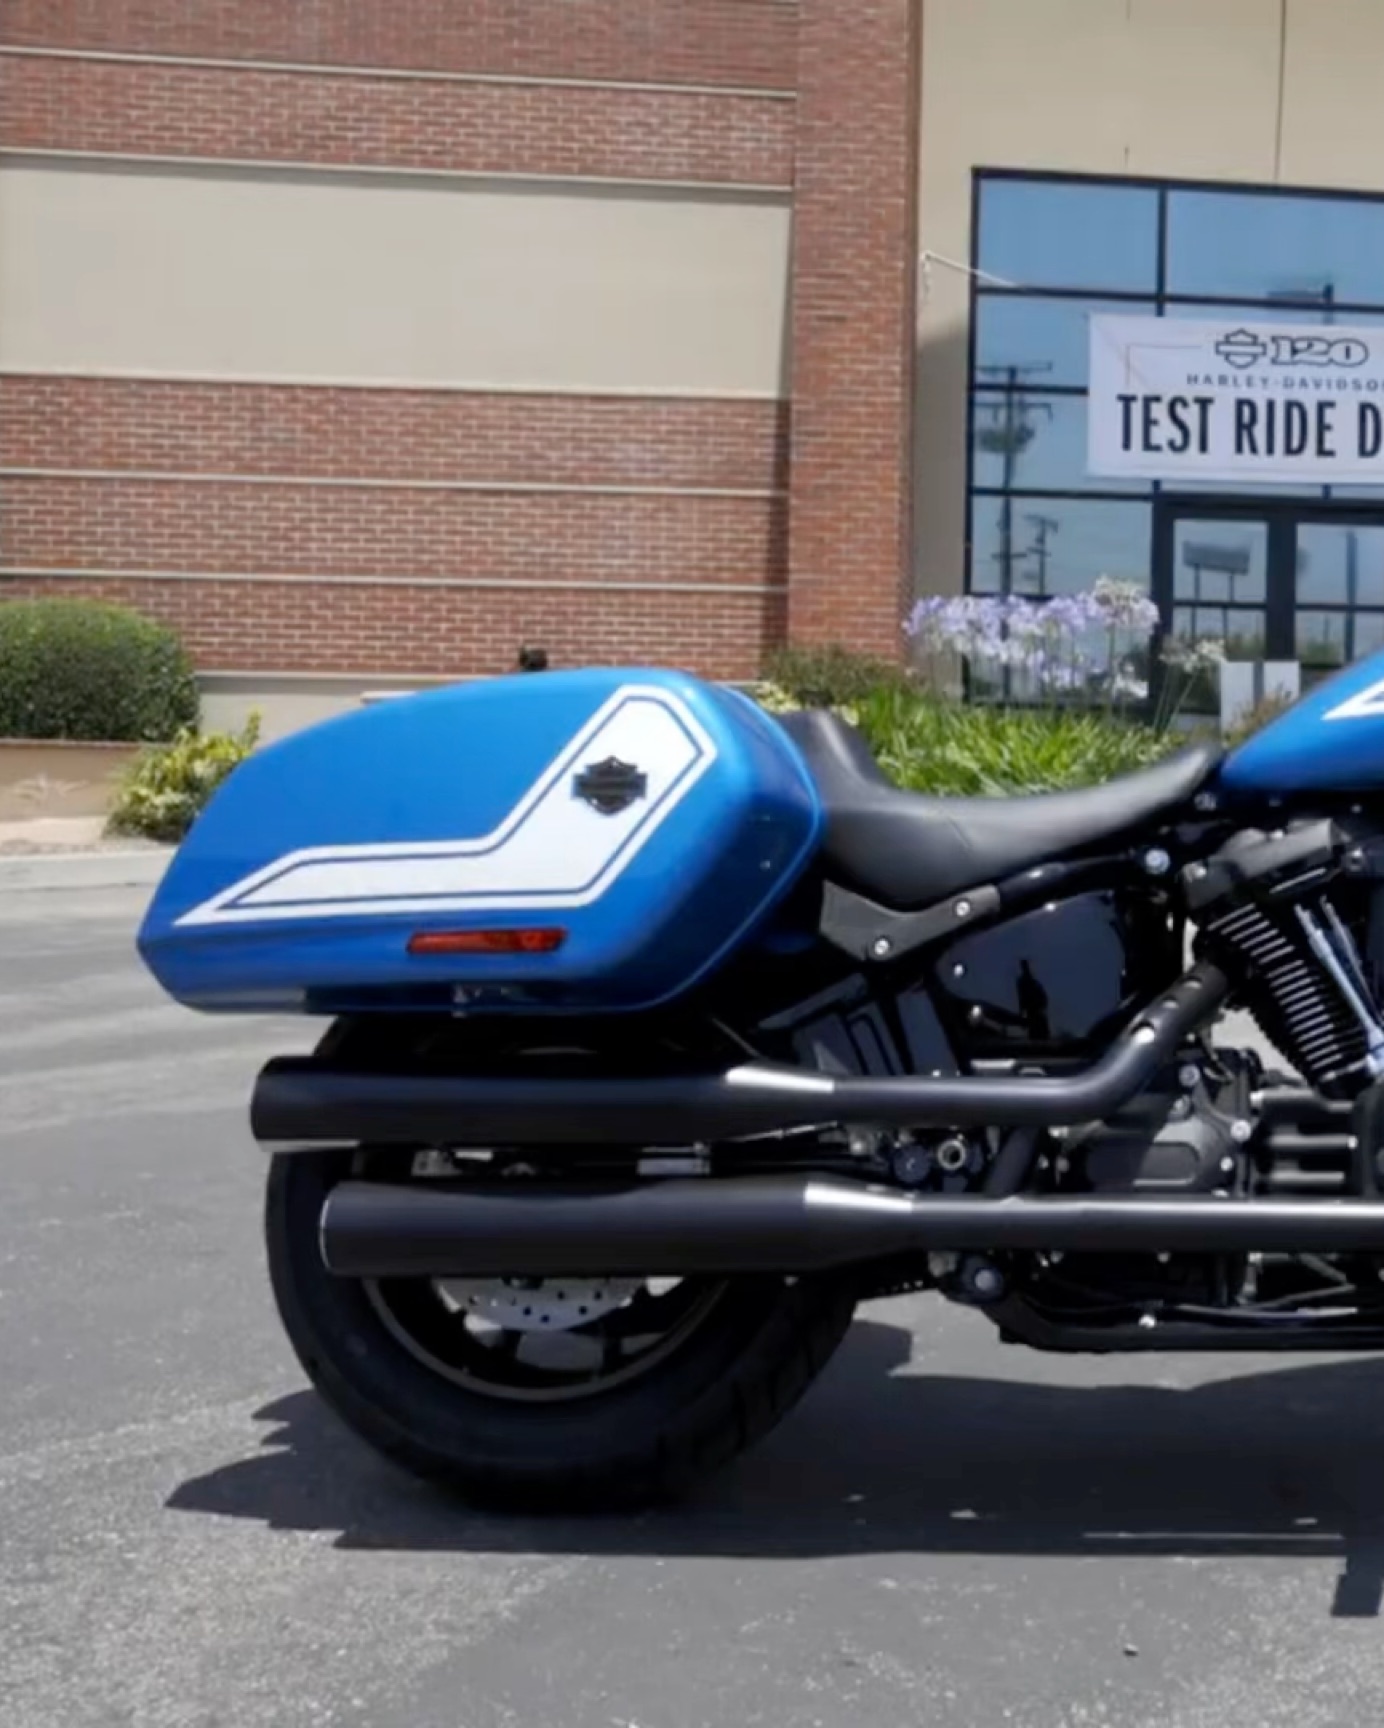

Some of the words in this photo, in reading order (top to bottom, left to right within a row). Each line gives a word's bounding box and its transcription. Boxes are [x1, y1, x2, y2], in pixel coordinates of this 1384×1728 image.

[1271, 335, 1369, 368] 120
[1117, 394, 1215, 454] TEST
[1234, 398, 1337, 458] RIDE
